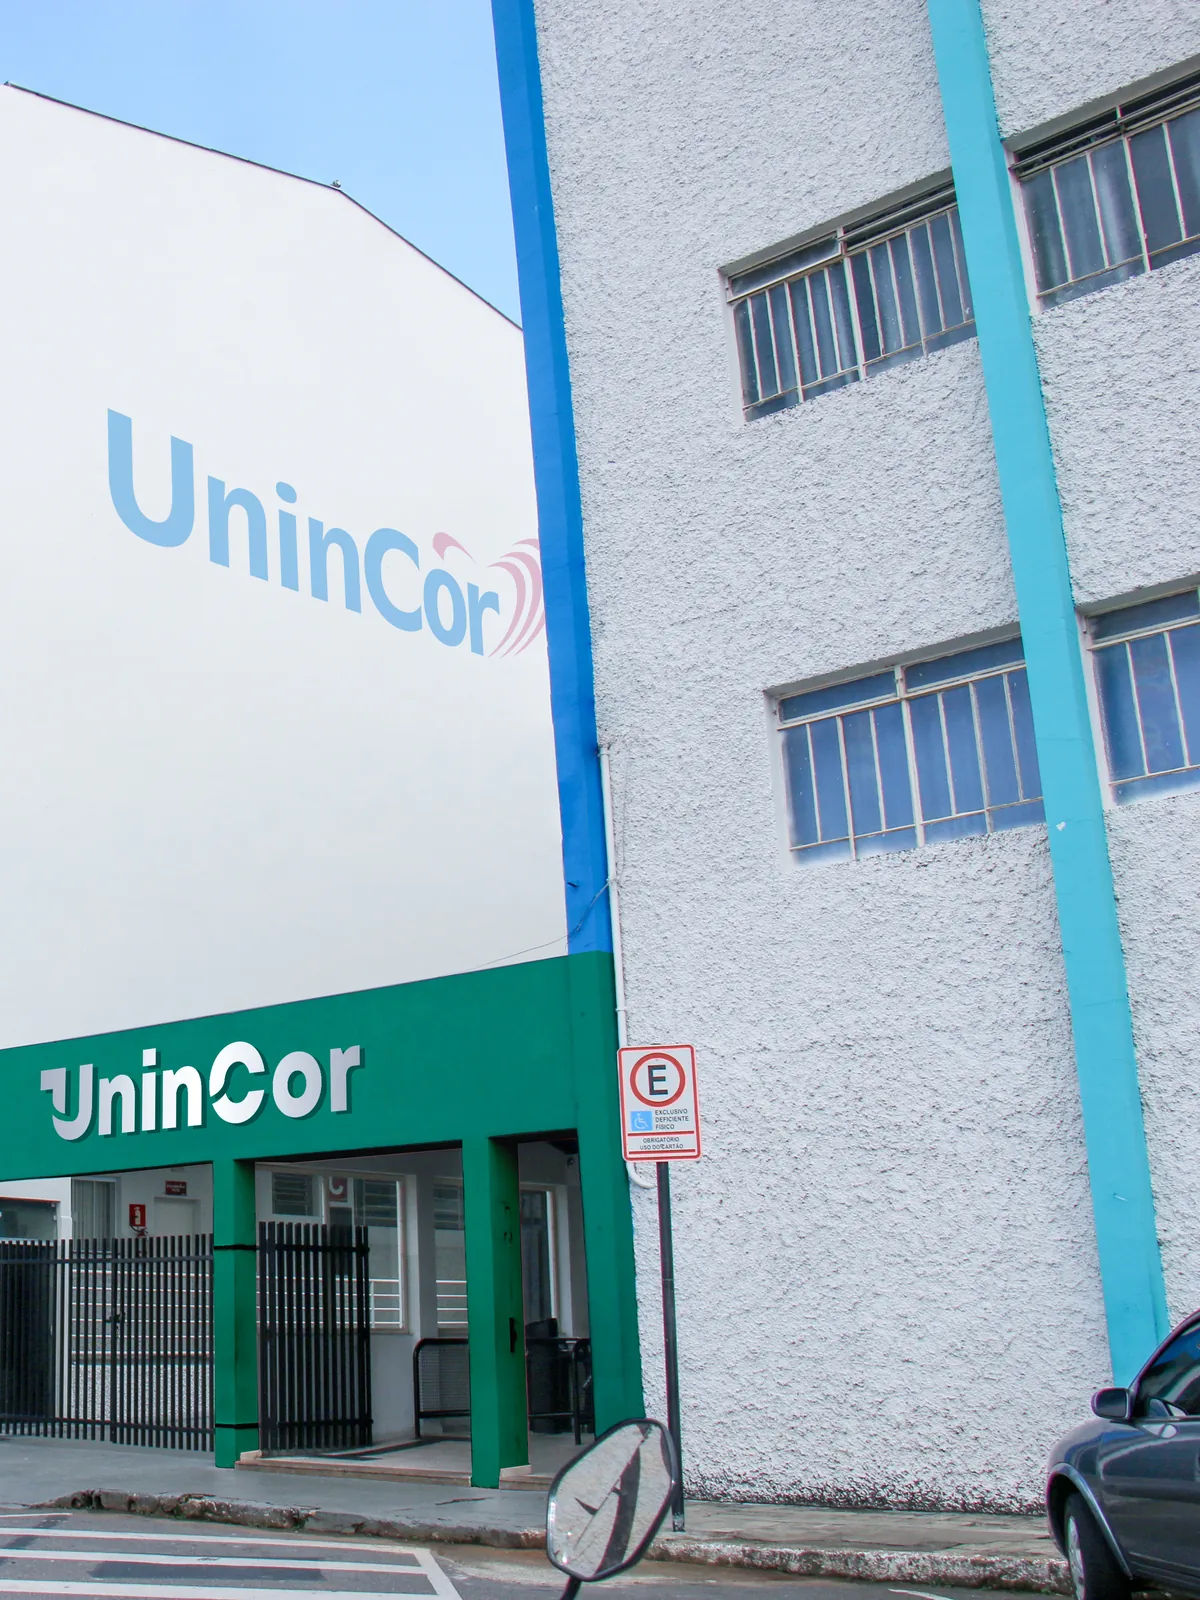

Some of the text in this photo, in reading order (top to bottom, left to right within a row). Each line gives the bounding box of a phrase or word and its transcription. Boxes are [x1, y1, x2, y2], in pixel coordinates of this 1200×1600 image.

[107, 408, 500, 656] UninCor
[40, 1041, 362, 1141] UninCor
[647, 1064, 668, 1096] E
